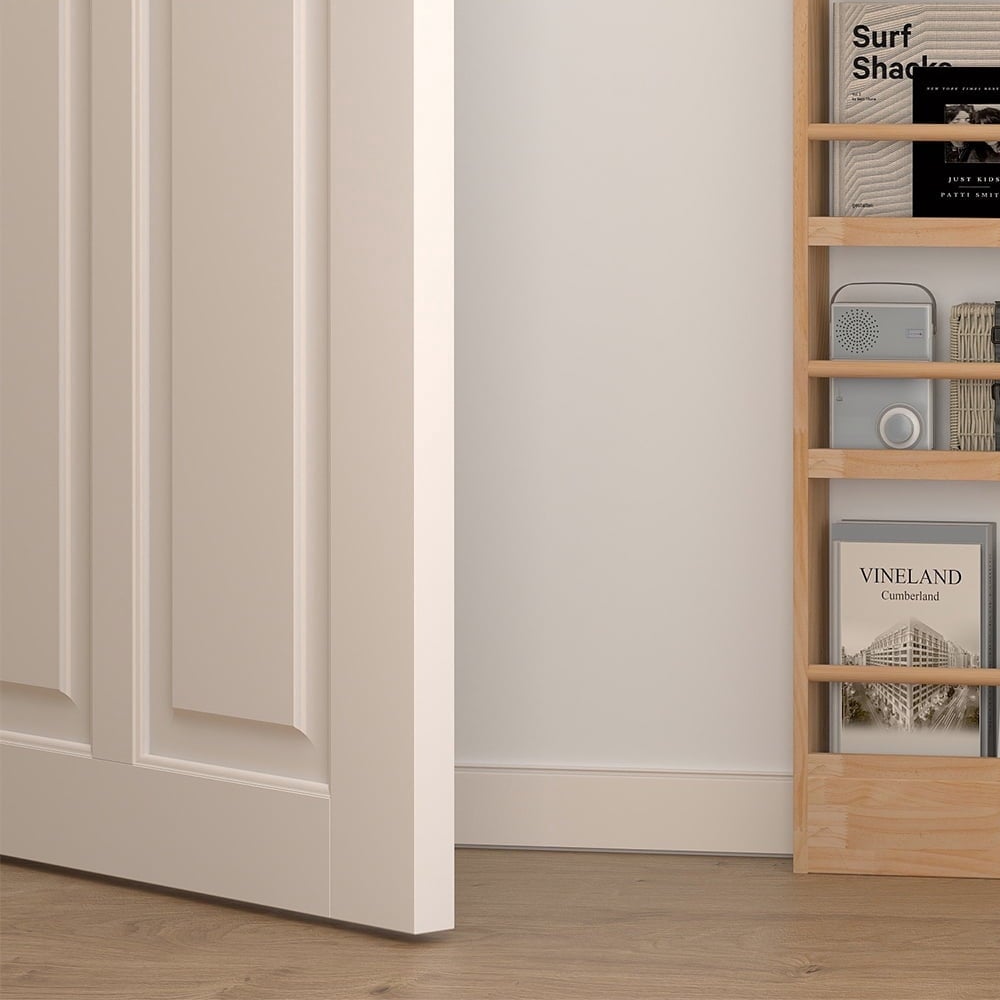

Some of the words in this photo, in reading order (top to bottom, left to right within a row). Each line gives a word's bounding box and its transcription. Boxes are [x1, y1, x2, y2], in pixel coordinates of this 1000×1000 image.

[853, 23, 912, 48] Surf
[948, 176, 972, 184] JUST
[860, 567, 962, 585] VINELAND
[881, 590, 940, 601] Cumberland
